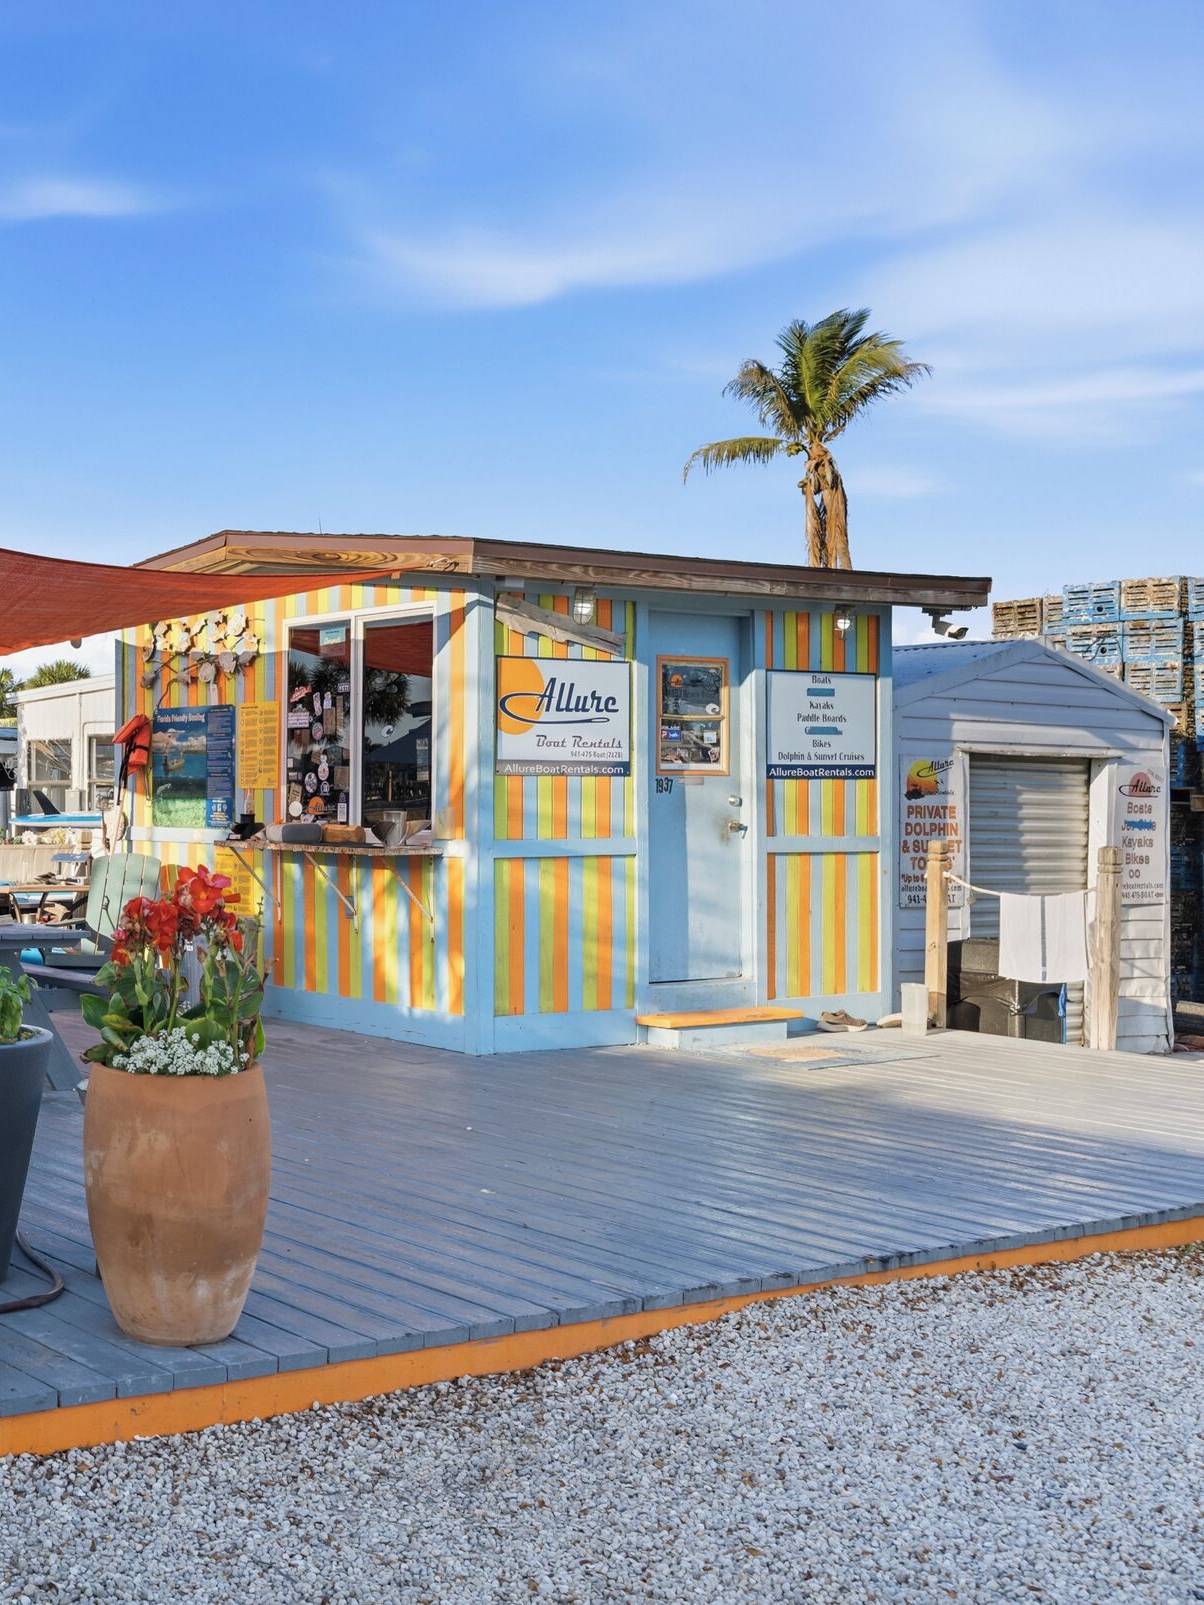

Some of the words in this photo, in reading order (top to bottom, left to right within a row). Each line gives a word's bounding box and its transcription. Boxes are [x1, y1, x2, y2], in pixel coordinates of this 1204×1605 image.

[811, 675, 832, 685] Boats
[514, 677, 620, 716] Allure
[809, 701, 835, 710] Kayaks
[797, 713, 820, 723] Paddle
[823, 714, 847, 723] Boards
[535, 734, 567, 748] Boat
[571, 735, 624, 749] Rentals
[812, 739, 832, 748] Bikes
[778, 752, 805, 762] Dolphin
[806, 752, 812, 761] &
[814, 752, 837, 761] Sunset
[839, 752, 865, 761] Cruises
[504, 763, 624, 775] AllureBoatRentals.com
[769, 767, 874, 777] AllureBoatRentals.com
[655, 777, 674, 794] 1937
[907, 805, 957, 819] PRIVATE
[1127, 801, 1153, 814] Boats
[904, 821, 959, 836] DOLPHIN
[902, 839, 910, 854] &
[912, 839, 963, 853] SUET
